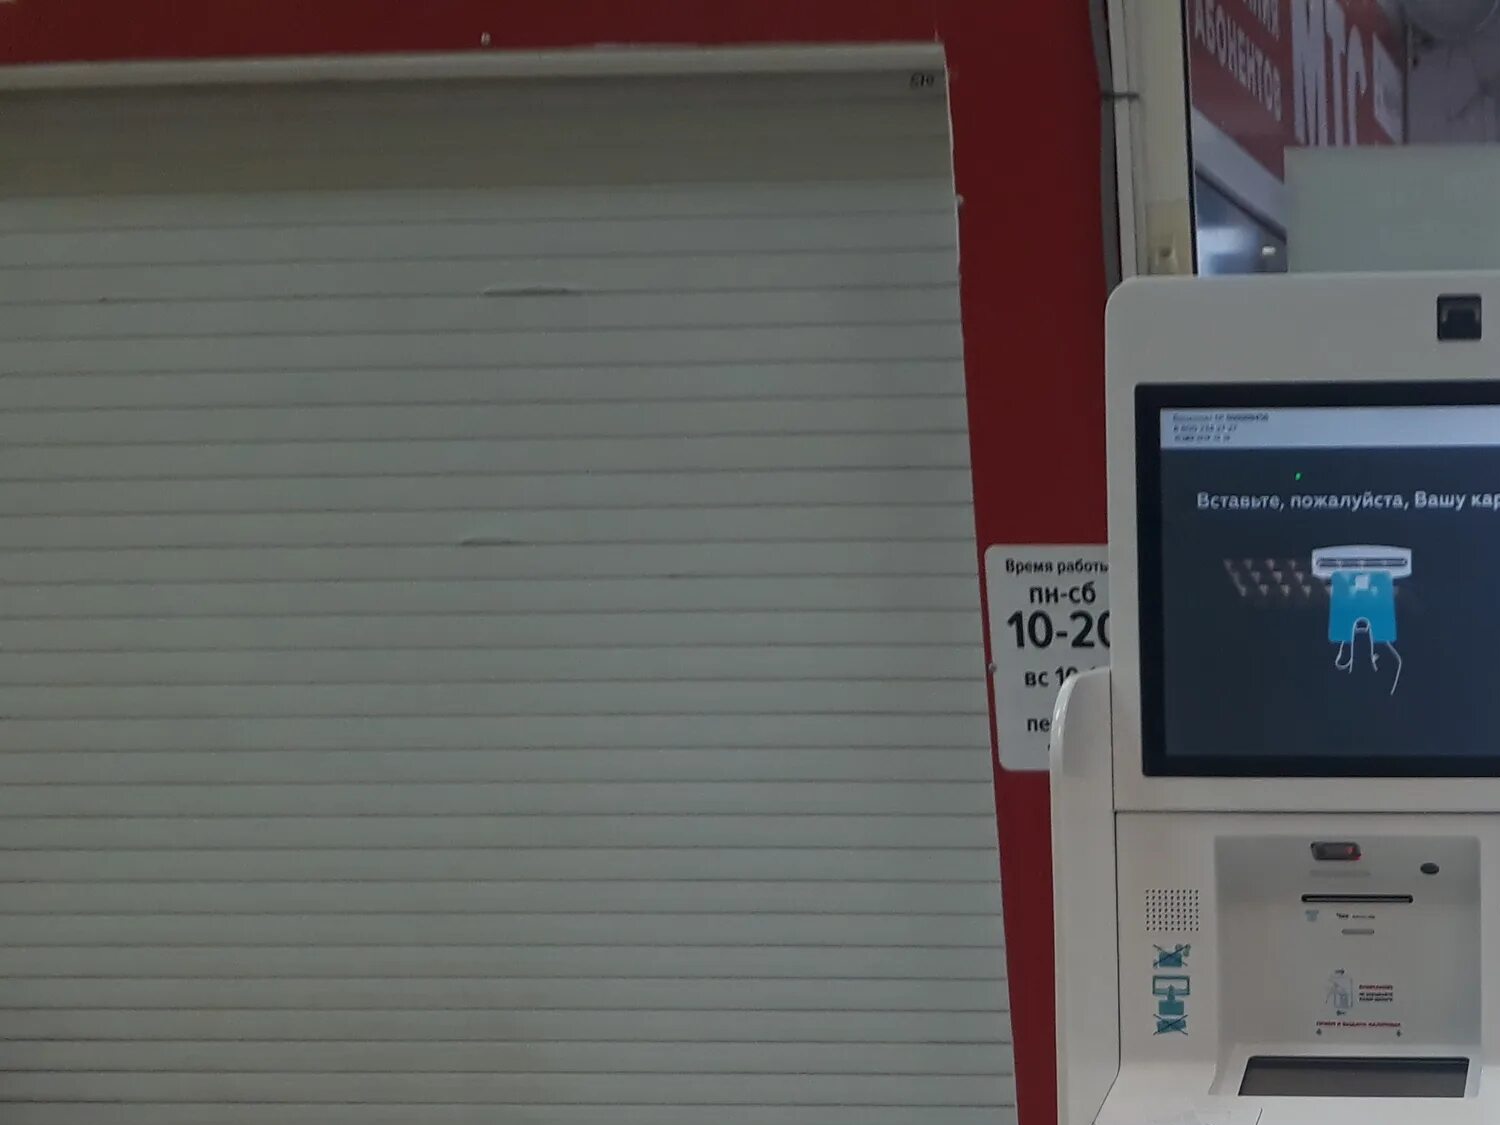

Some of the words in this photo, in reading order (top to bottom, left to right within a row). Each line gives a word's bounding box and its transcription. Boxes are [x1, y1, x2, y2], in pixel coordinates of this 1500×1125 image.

[1197, 492, 1285, 512] Вставьте,
[1290, 490, 1408, 512] пожалуйста,
[1414, 490, 1465, 511] Вашу
[1006, 558, 1053, 576] Время
[1029, 580, 1096, 604] пн-сб
[1024, 671, 1049, 688] вс
